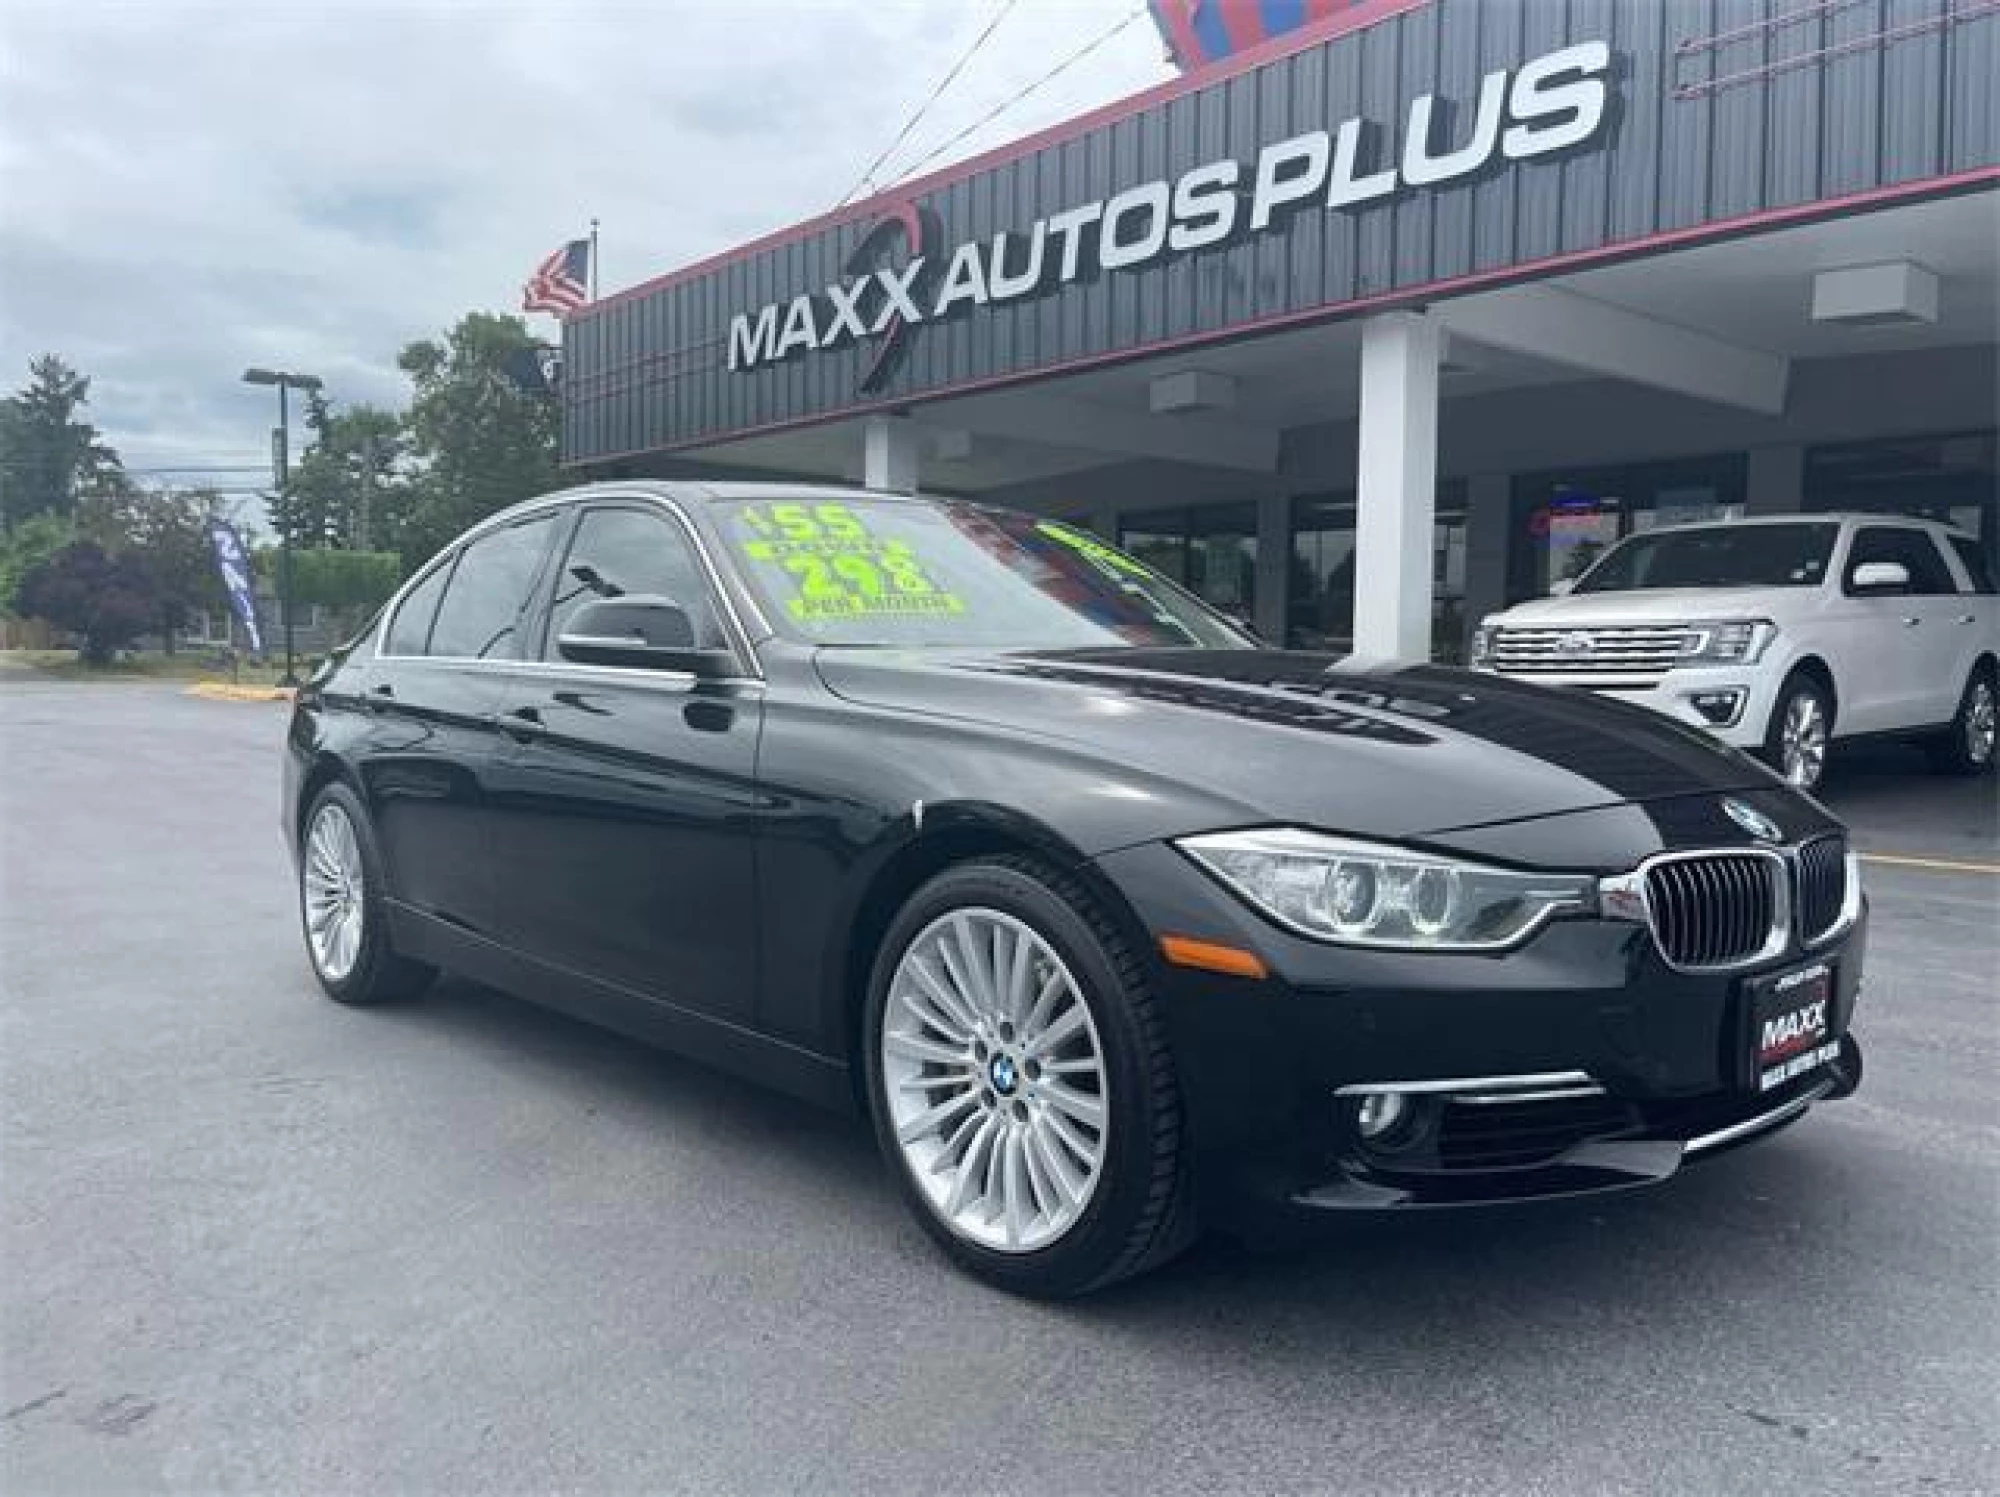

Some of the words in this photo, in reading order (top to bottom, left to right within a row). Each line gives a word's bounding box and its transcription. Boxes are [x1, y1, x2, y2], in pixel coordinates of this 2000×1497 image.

[727, 256, 925, 371] MAXX
[932, 159, 1241, 317] AUTOS
[1249, 41, 1611, 230] PLUS
